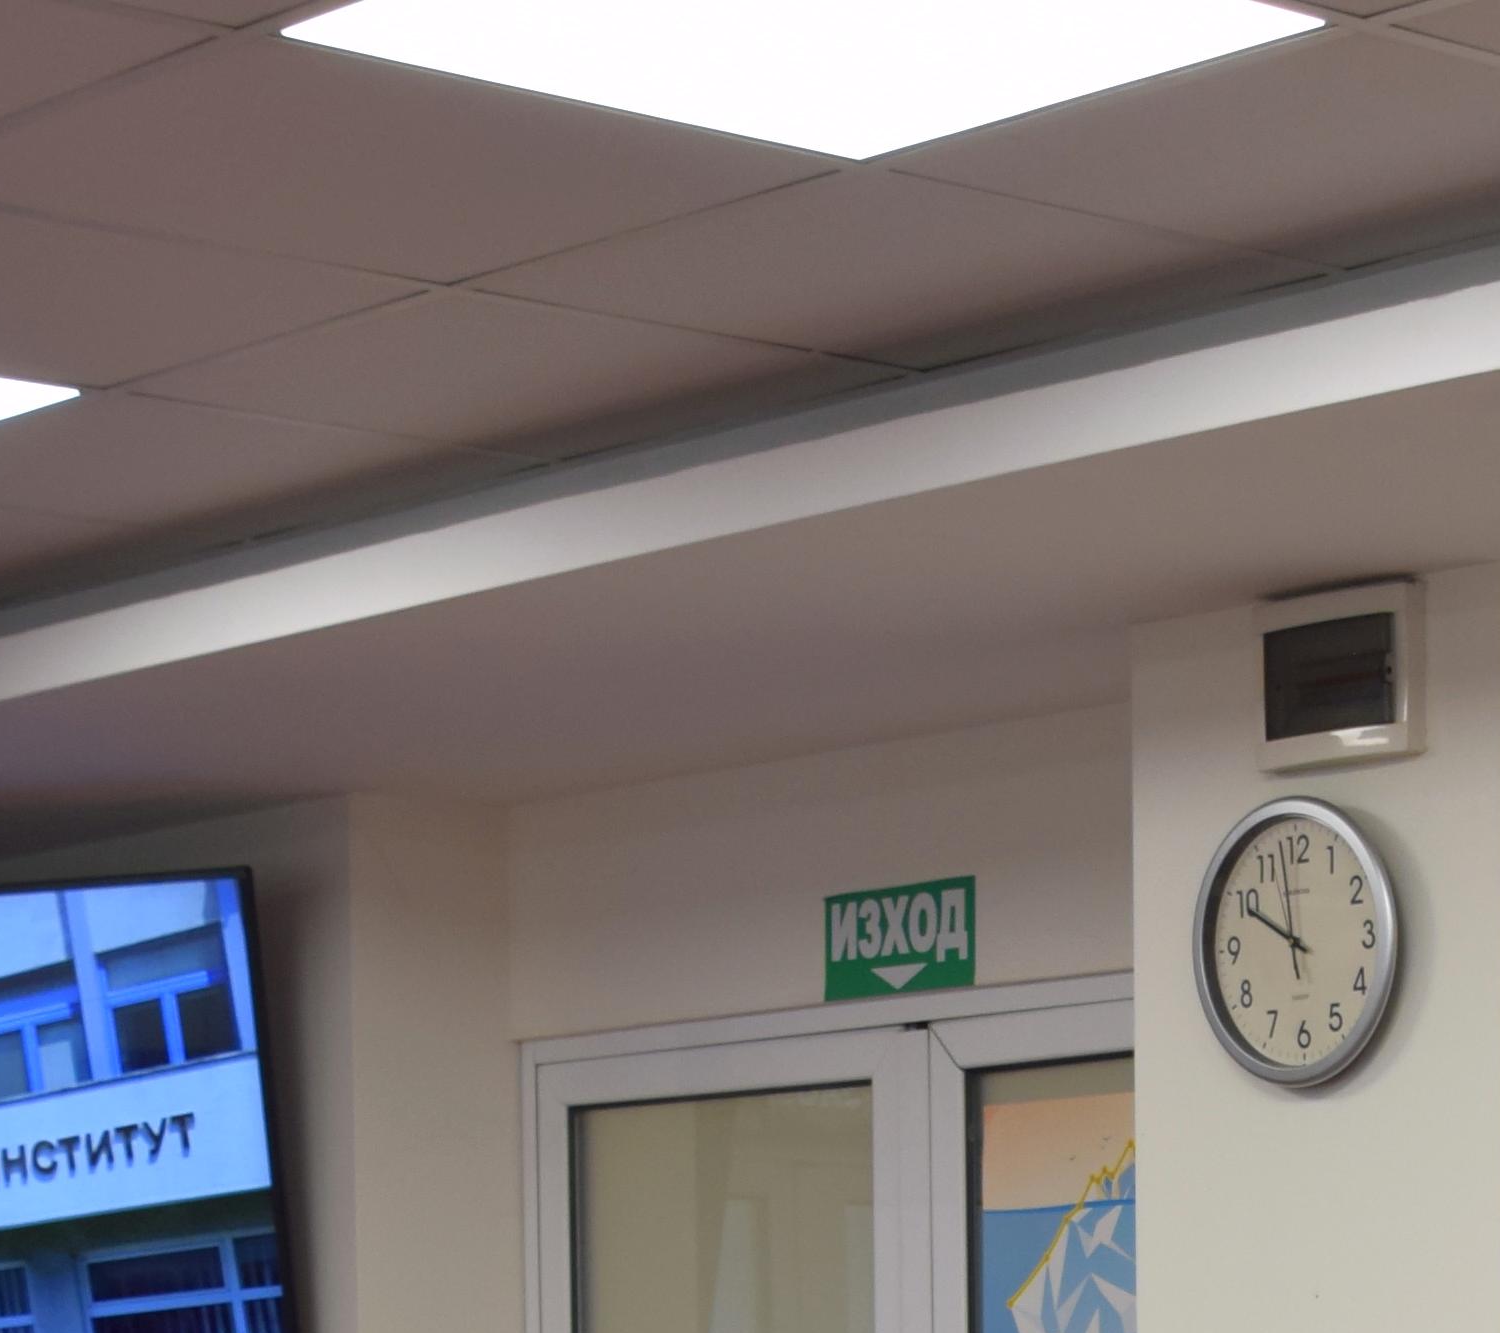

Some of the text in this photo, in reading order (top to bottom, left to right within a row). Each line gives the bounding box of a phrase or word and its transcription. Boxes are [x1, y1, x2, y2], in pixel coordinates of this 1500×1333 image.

[1286, 834, 1310, 865] 12
[1326, 846, 1335, 874] 1
[1257, 854, 1274, 883] 11
[1236, 889, 1259, 918] 10
[1349, 875, 1364, 905] 2
[831, 888, 968, 963] ИЗХОД
[1361, 919, 1376, 949] 3
[1227, 936, 1241, 965] 9
[1240, 979, 1252, 1008] 8
[1353, 966, 1367, 995] 4
[1267, 1010, 1278, 1039] 7
[1328, 1003, 1343, 1032] 5
[1297, 1020, 1311, 1048] 6
